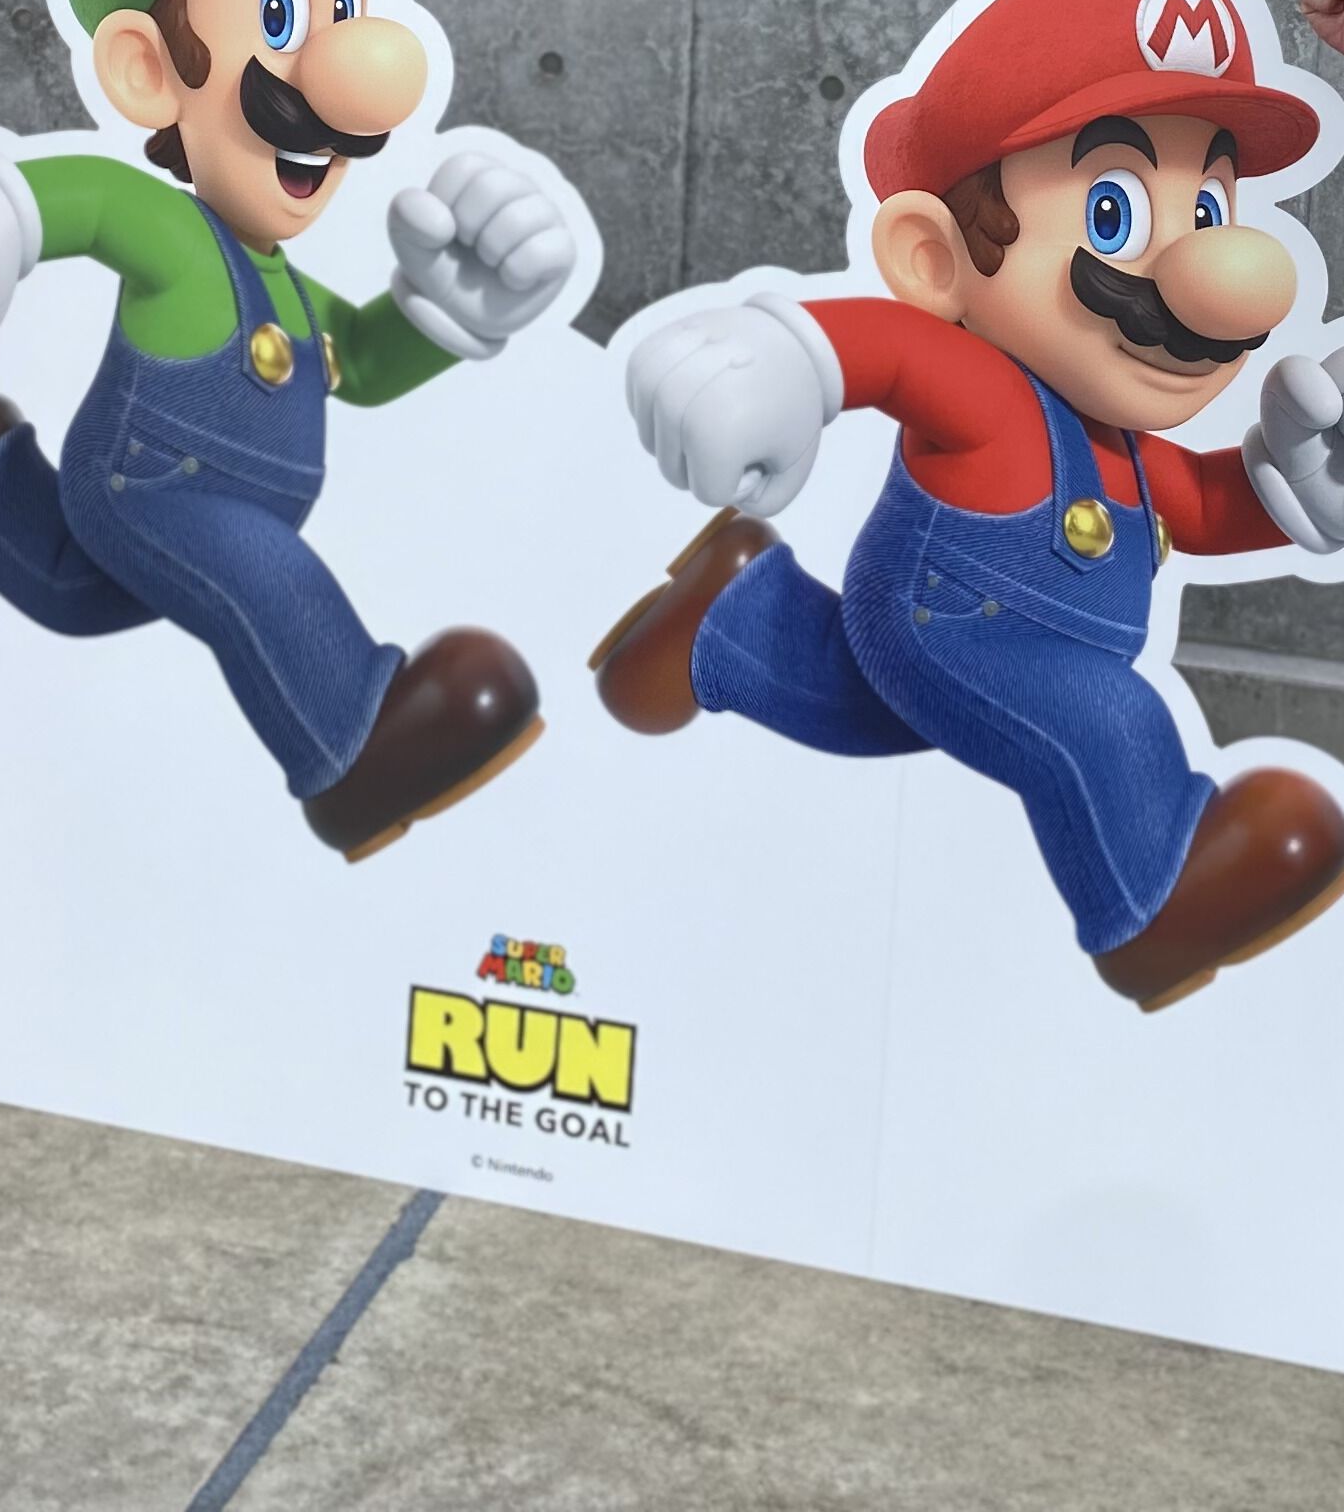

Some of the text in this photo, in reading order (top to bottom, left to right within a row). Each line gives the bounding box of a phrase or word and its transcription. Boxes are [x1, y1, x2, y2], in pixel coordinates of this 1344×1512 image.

[491, 933, 566, 968] SUPER
[476, 952, 576, 996] MARIO
[404, 984, 637, 1115] RUN
[404, 1081, 630, 1148] TO THE GOAL
[488, 1157, 554, 1183] Nintendo
